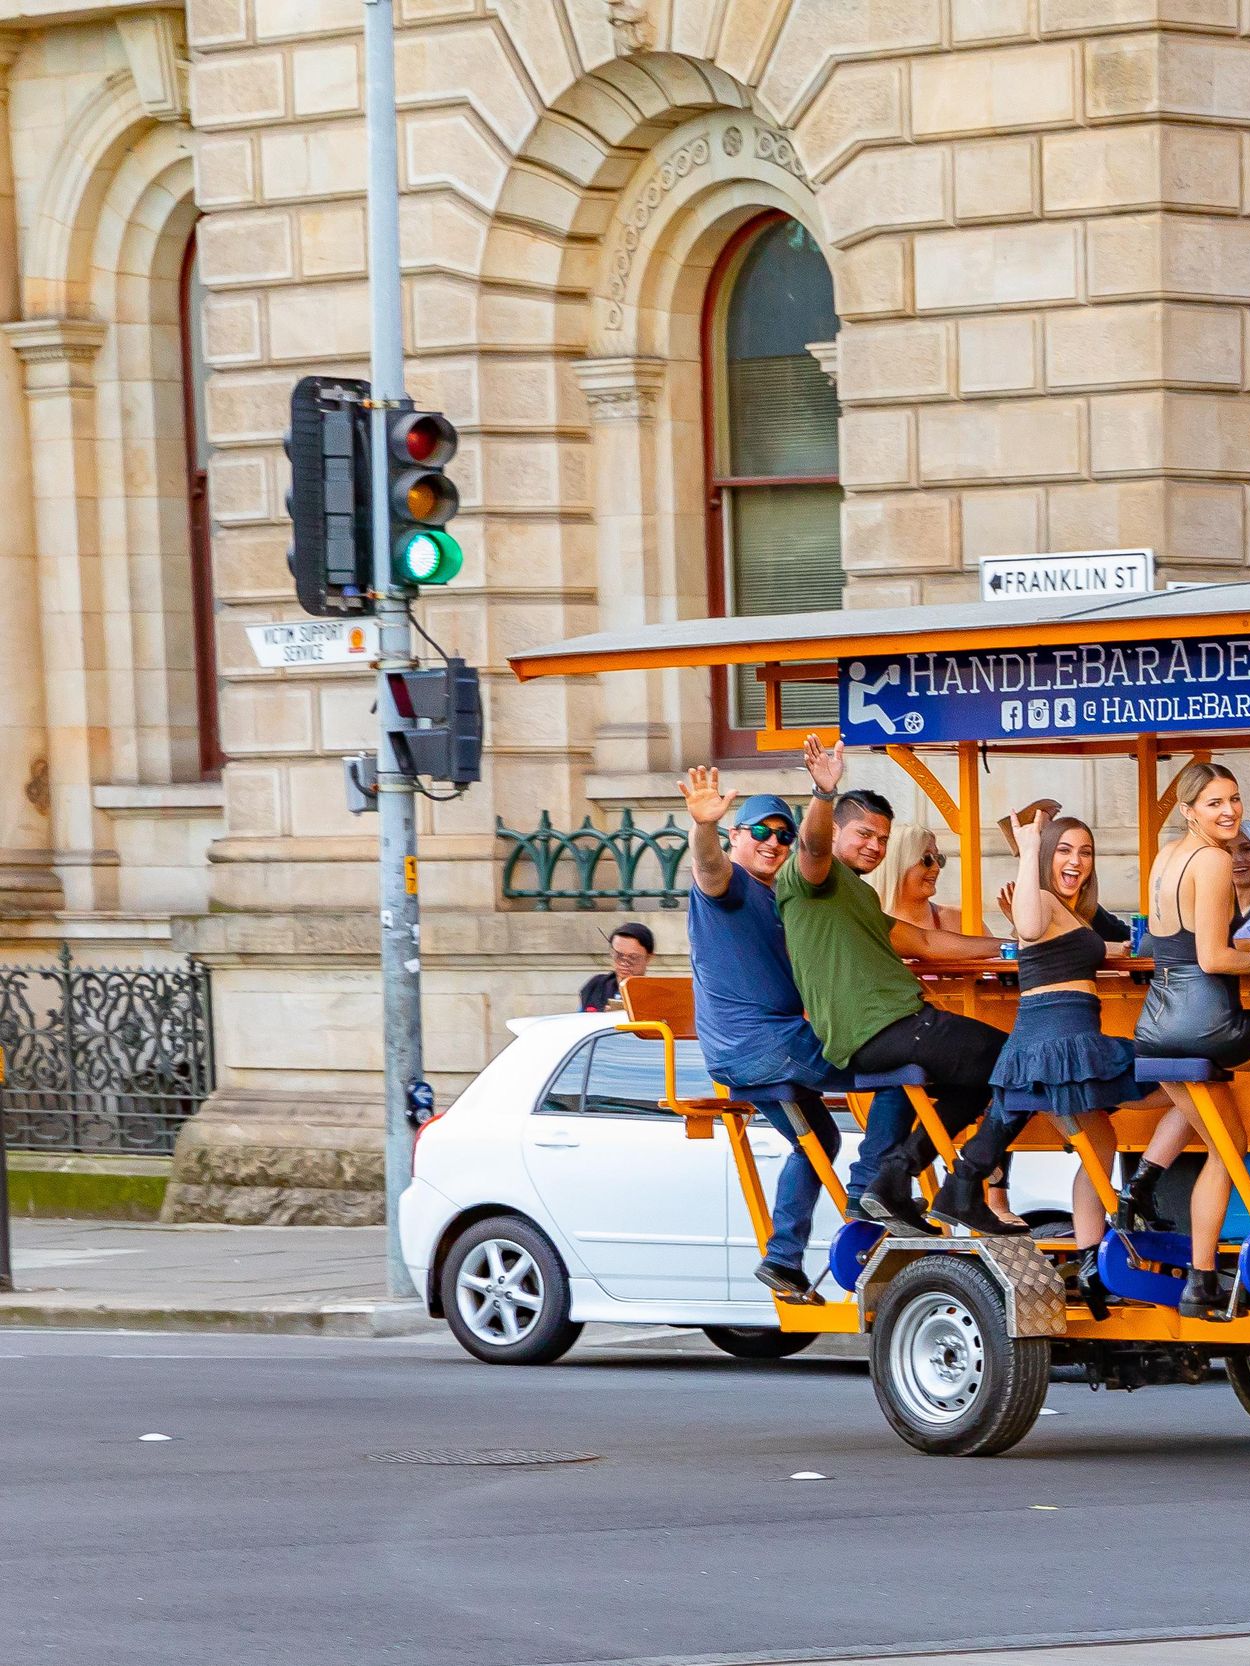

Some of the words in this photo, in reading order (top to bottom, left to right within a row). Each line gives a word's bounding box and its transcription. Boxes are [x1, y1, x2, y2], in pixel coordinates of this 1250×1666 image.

[1005, 568, 1107, 593] FRANKLIN
[1115, 566, 1137, 588] ST
[263, 628, 296, 646] VICTIM
[299, 623, 344, 642] SUPPORT
[283, 644, 324, 662] SERVICE
